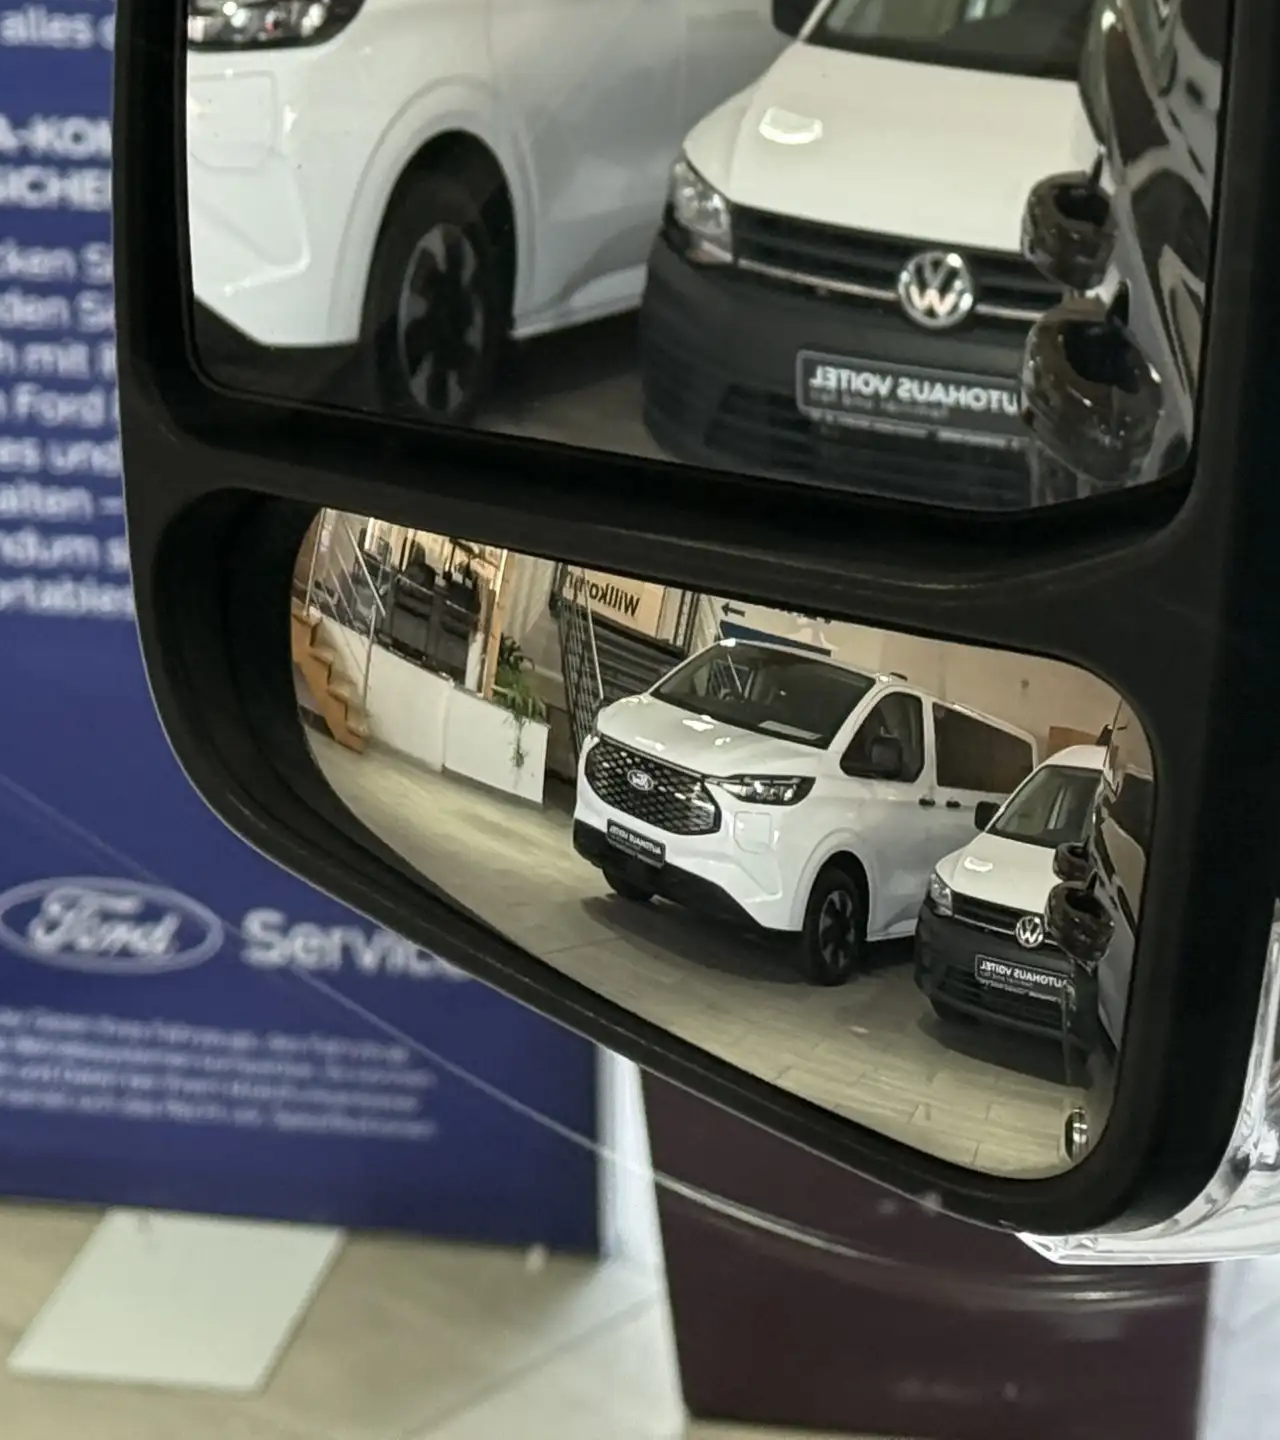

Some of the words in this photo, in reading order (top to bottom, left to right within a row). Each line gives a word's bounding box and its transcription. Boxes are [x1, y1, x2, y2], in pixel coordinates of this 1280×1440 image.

[0, 6, 96, 48] alles
[18, 342, 89, 378] mit
[11, 383, 106, 428] Ford
